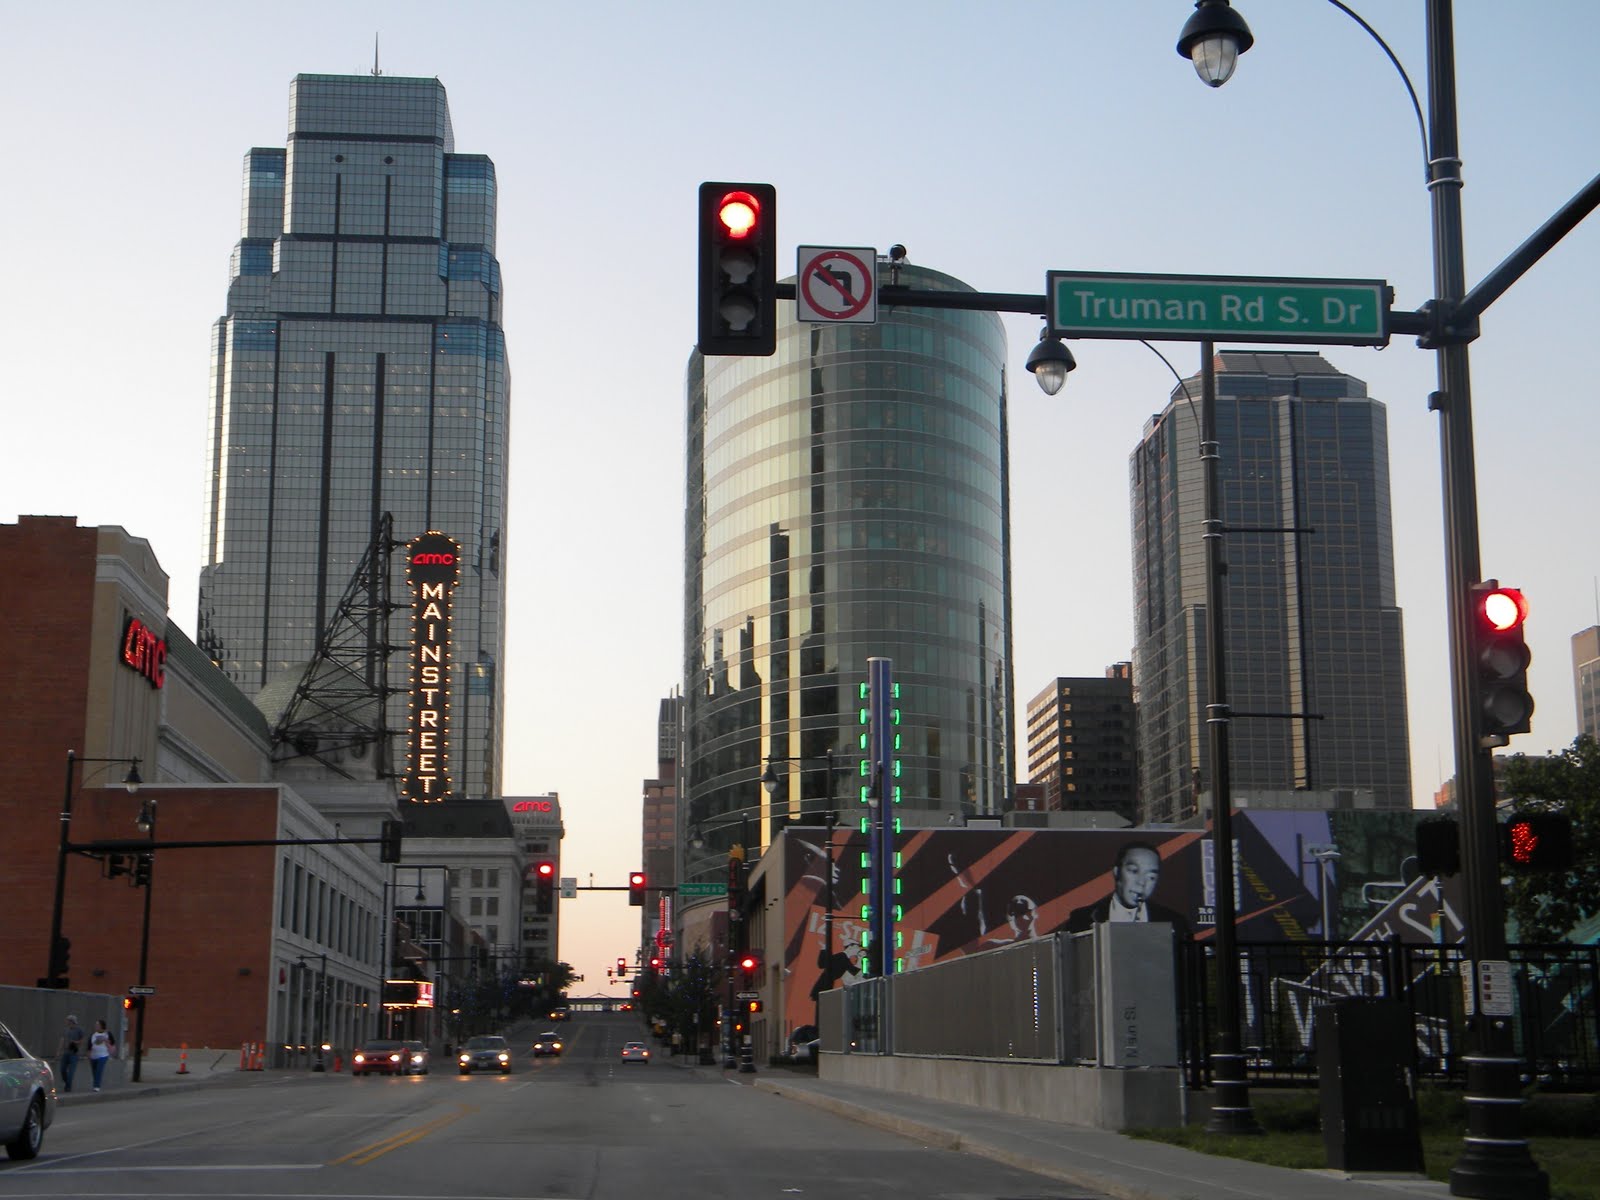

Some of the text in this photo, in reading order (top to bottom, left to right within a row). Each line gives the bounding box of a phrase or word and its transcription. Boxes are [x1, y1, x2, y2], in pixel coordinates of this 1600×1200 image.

[1073, 290, 1362, 325] Truman Rd S. Dr
[418, 582, 443, 794] MAINSTREET
